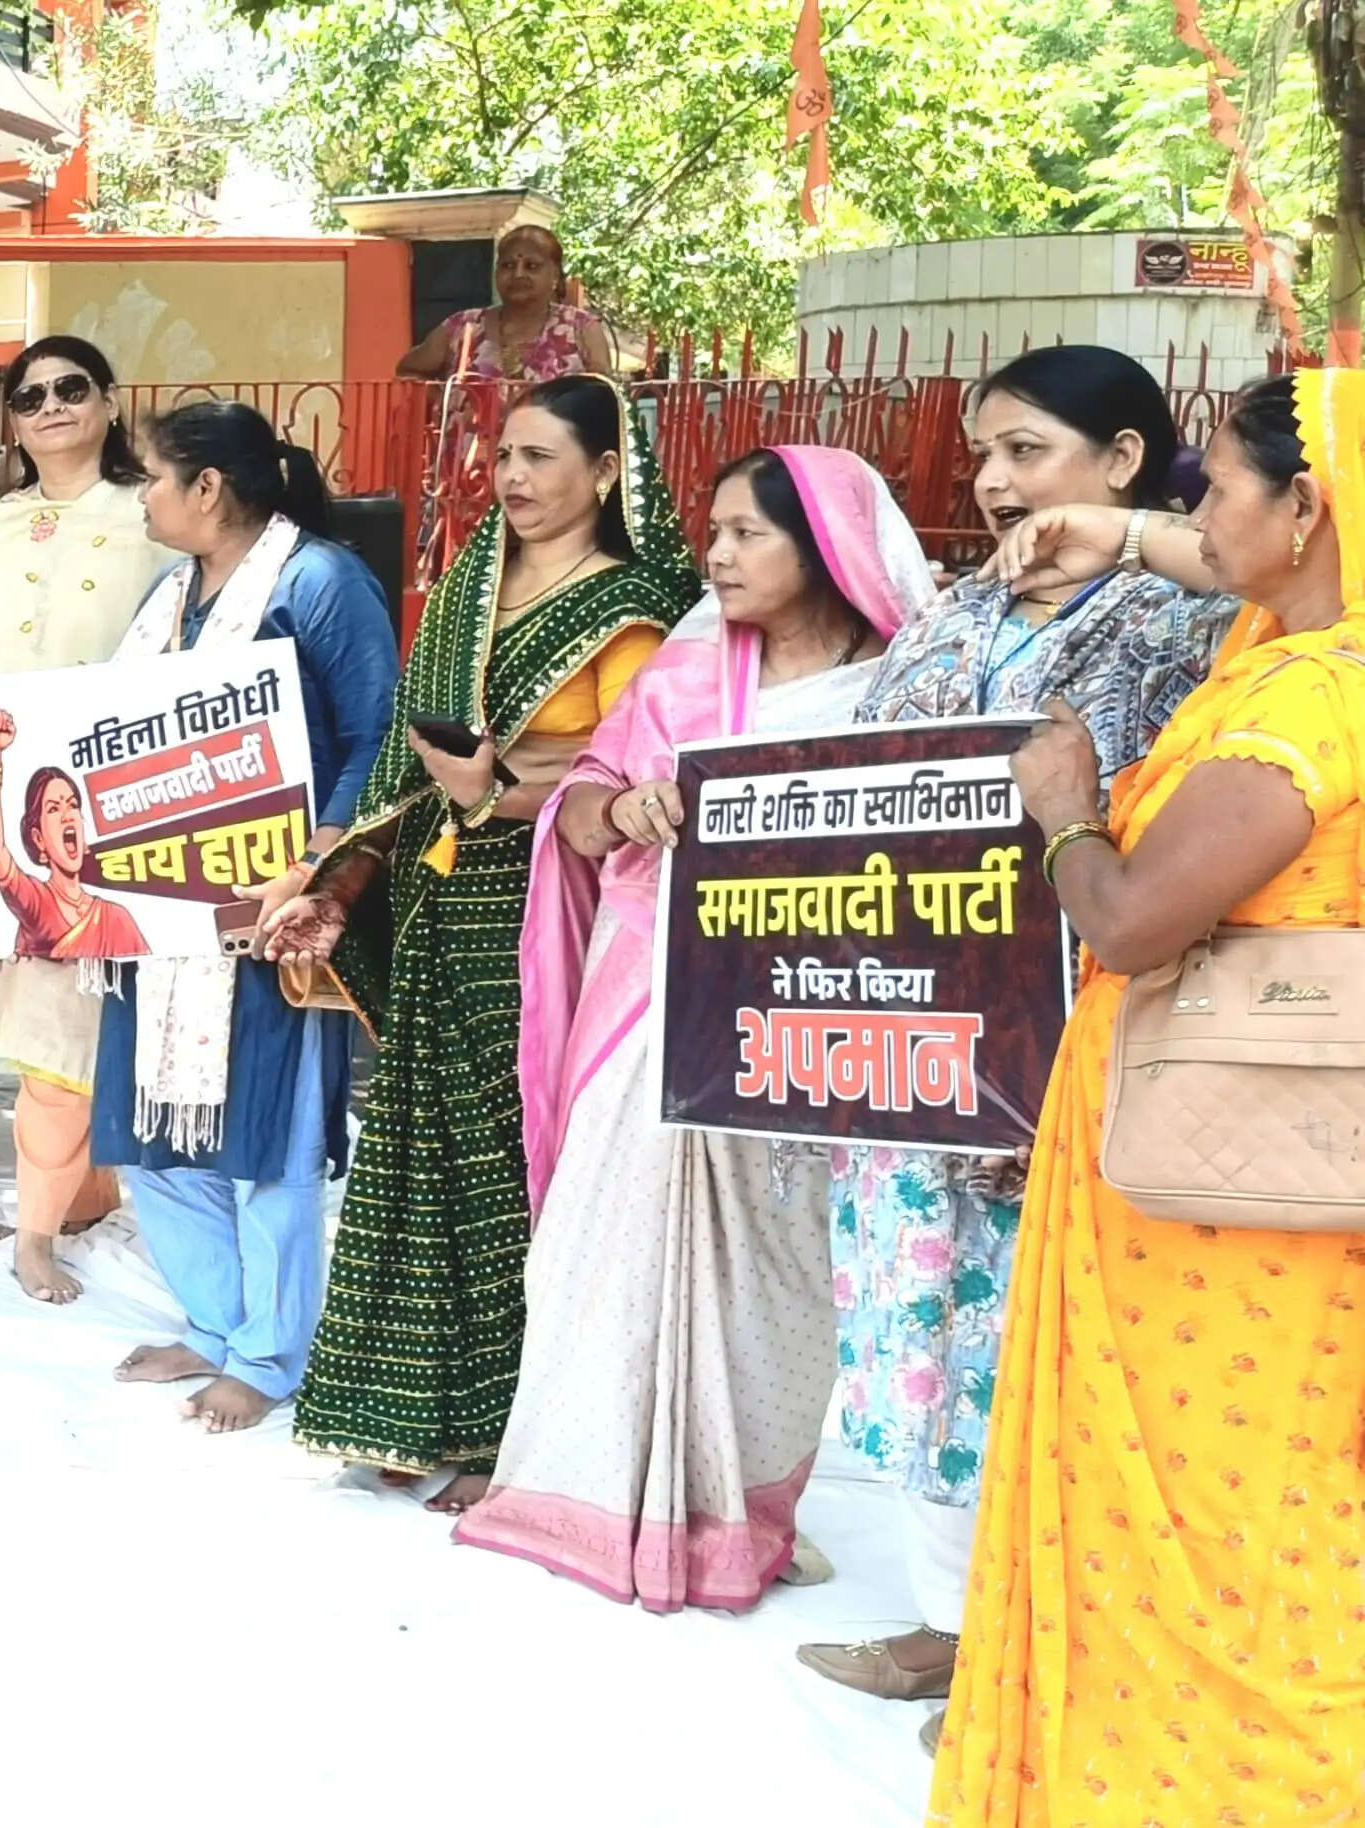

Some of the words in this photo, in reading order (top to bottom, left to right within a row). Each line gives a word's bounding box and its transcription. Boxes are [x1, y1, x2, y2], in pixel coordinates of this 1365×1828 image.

[69, 716, 167, 769] महिला
[173, 667, 281, 741] विरोधी
[96, 750, 216, 823] समाजवादी
[211, 731, 267, 785] पार्टी
[705, 783, 758, 836] नारी
[760, 779, 819, 832] शक्ति
[822, 788, 859, 829] का
[862, 769, 1016, 826] स्वाभिमान
[94, 833, 189, 885] हाय
[696, 851, 899, 938] समाजवादी
[907, 845, 1023, 936] पार्टी
[770, 955, 793, 1001] ने
[796, 956, 854, 1002] फिर
[856, 956, 936, 1003] किया
[735, 1006, 985, 1117] अपमान
